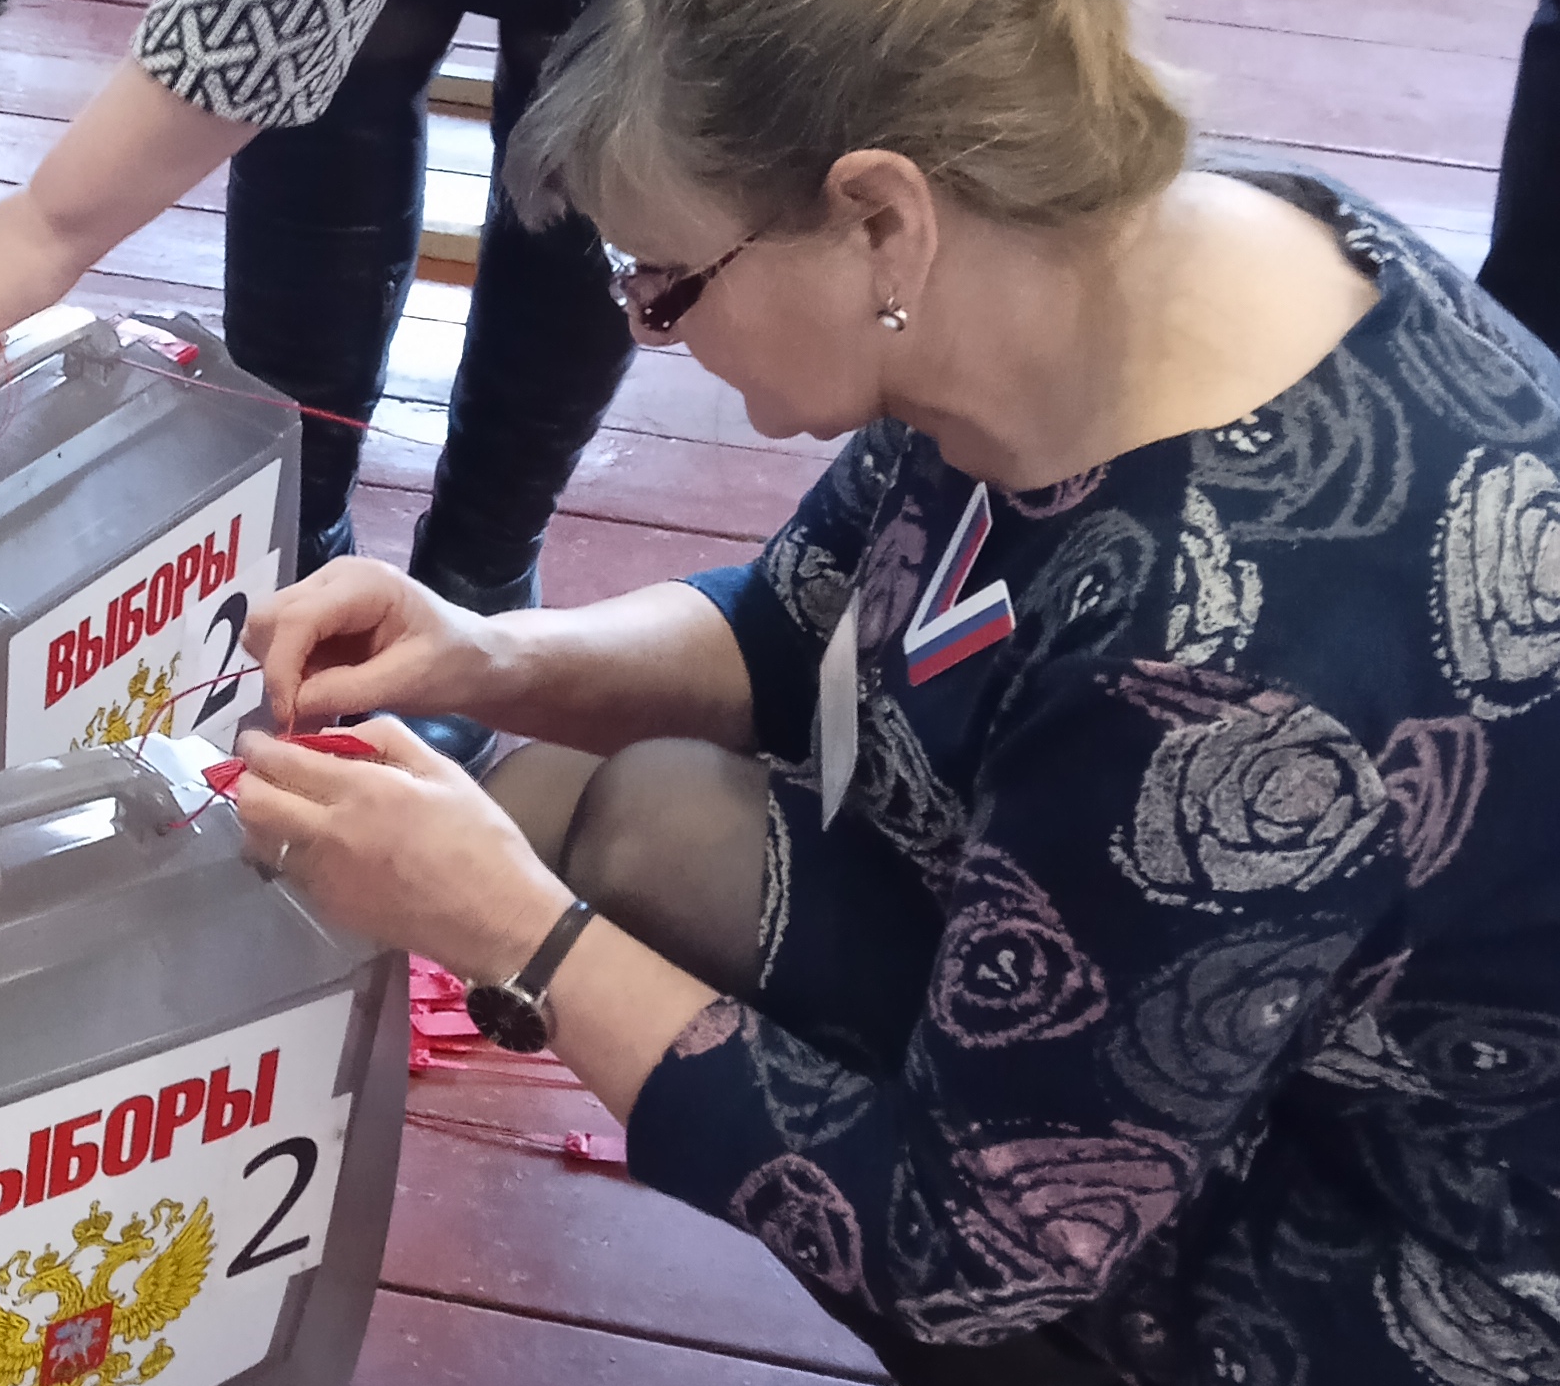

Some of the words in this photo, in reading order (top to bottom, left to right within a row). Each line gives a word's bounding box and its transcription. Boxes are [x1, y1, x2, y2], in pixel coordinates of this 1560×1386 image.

[43, 513, 242, 711] ВЫБОРЫ
[191, 591, 248, 732] 2
[226, 1135, 319, 1279] 2
